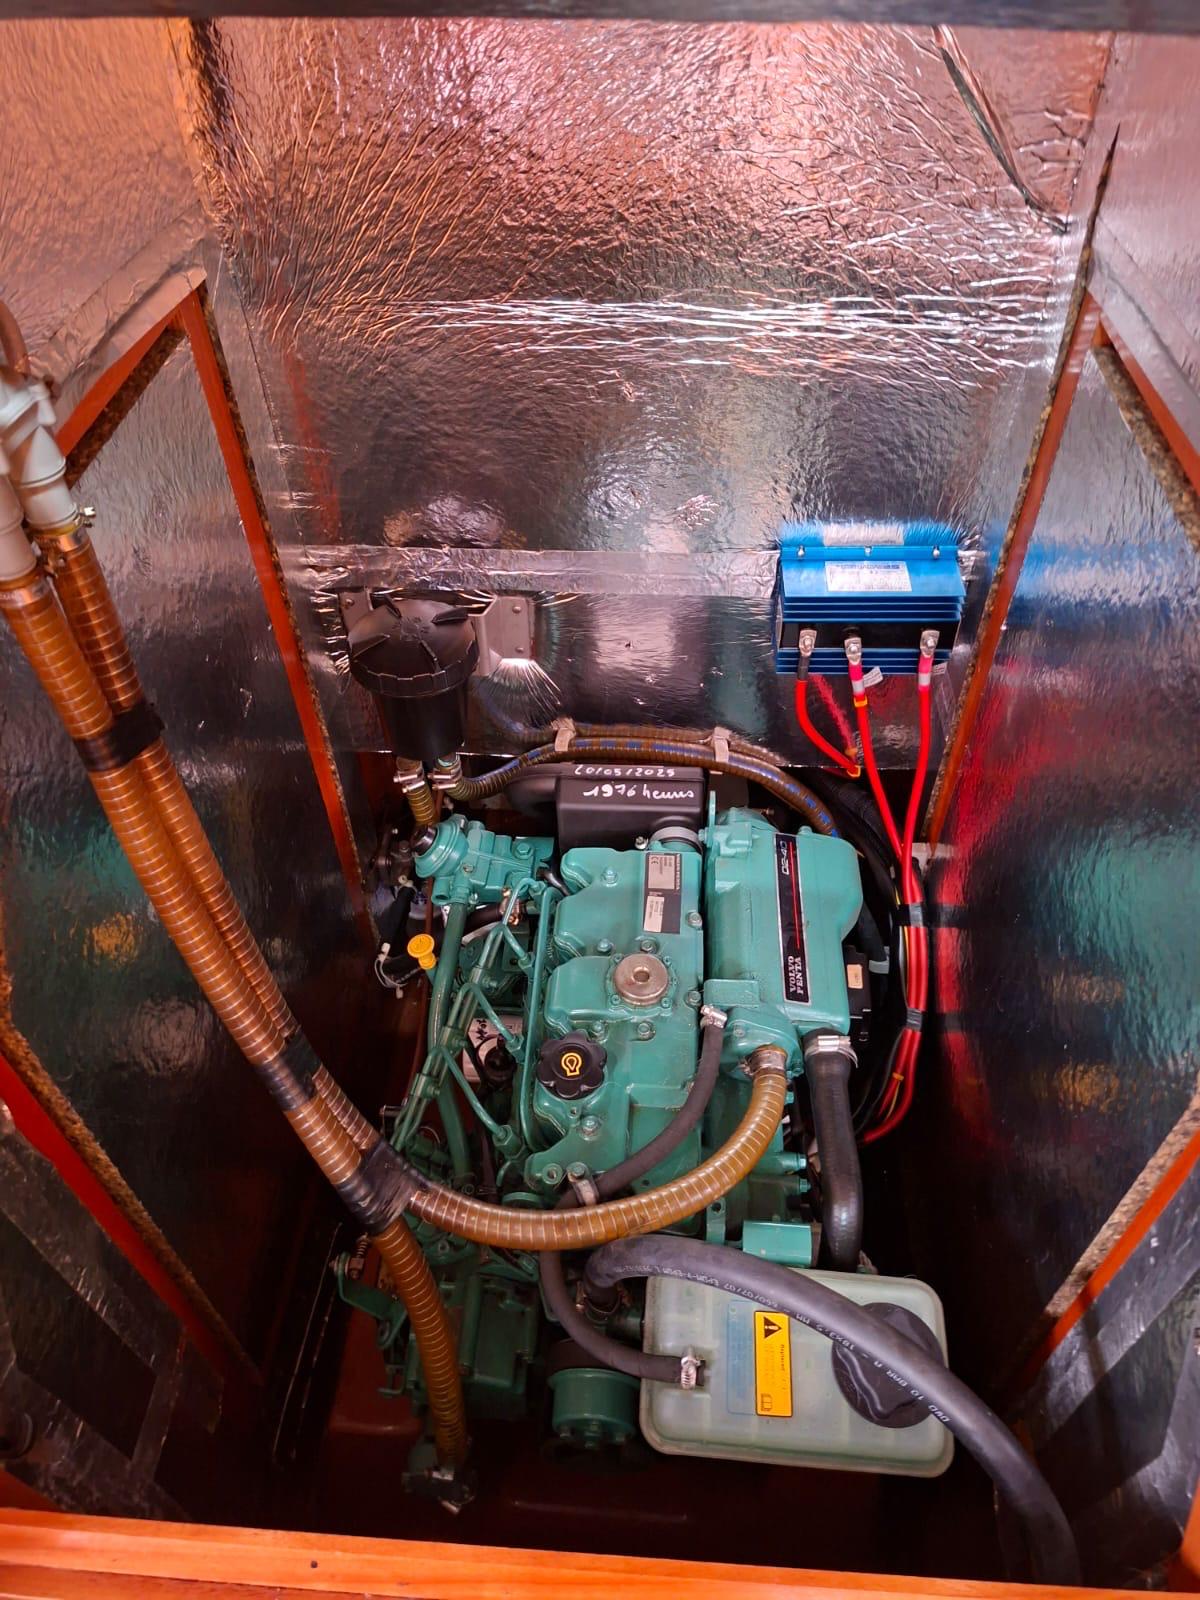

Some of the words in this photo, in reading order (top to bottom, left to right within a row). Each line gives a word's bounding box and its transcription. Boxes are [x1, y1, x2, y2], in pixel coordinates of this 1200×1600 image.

[583, 783, 637, 798] 1976
[780, 840, 789, 875] D2-40
[788, 955, 796, 992] VOLVO
[795, 956, 804, 994] PENTA
[796, 1313, 810, 1325] MM
[886, 1369, 908, 1387] BAR
